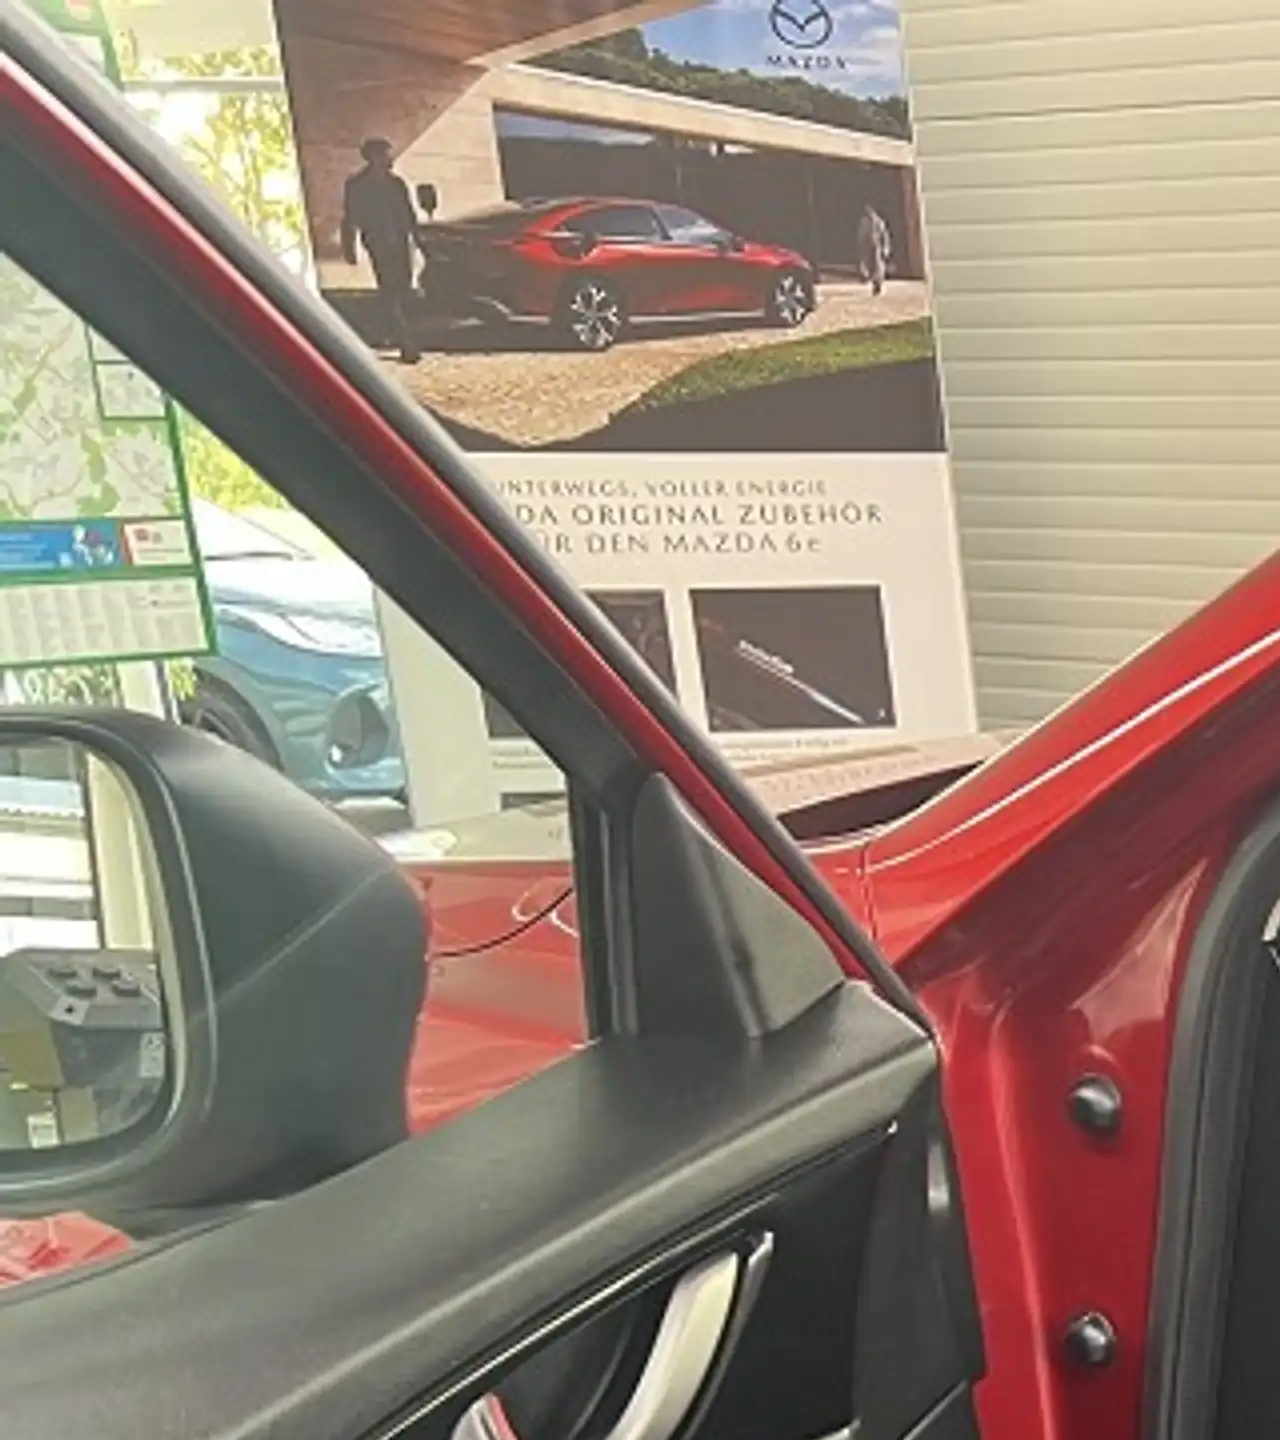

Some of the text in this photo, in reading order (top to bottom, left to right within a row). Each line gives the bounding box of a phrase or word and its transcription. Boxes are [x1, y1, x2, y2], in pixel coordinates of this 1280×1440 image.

[767, 55, 847, 70] MAZDA
[644, 479, 729, 497] VOLLER
[735, 479, 827, 497] ENERGIE
[572, 504, 725, 526] ORIGINAL
[738, 500, 883, 526] ZUBEHÖR
[586, 532, 649, 554] DEN
[663, 532, 778, 554] MAZDA
[786, 531, 821, 554] 6e
